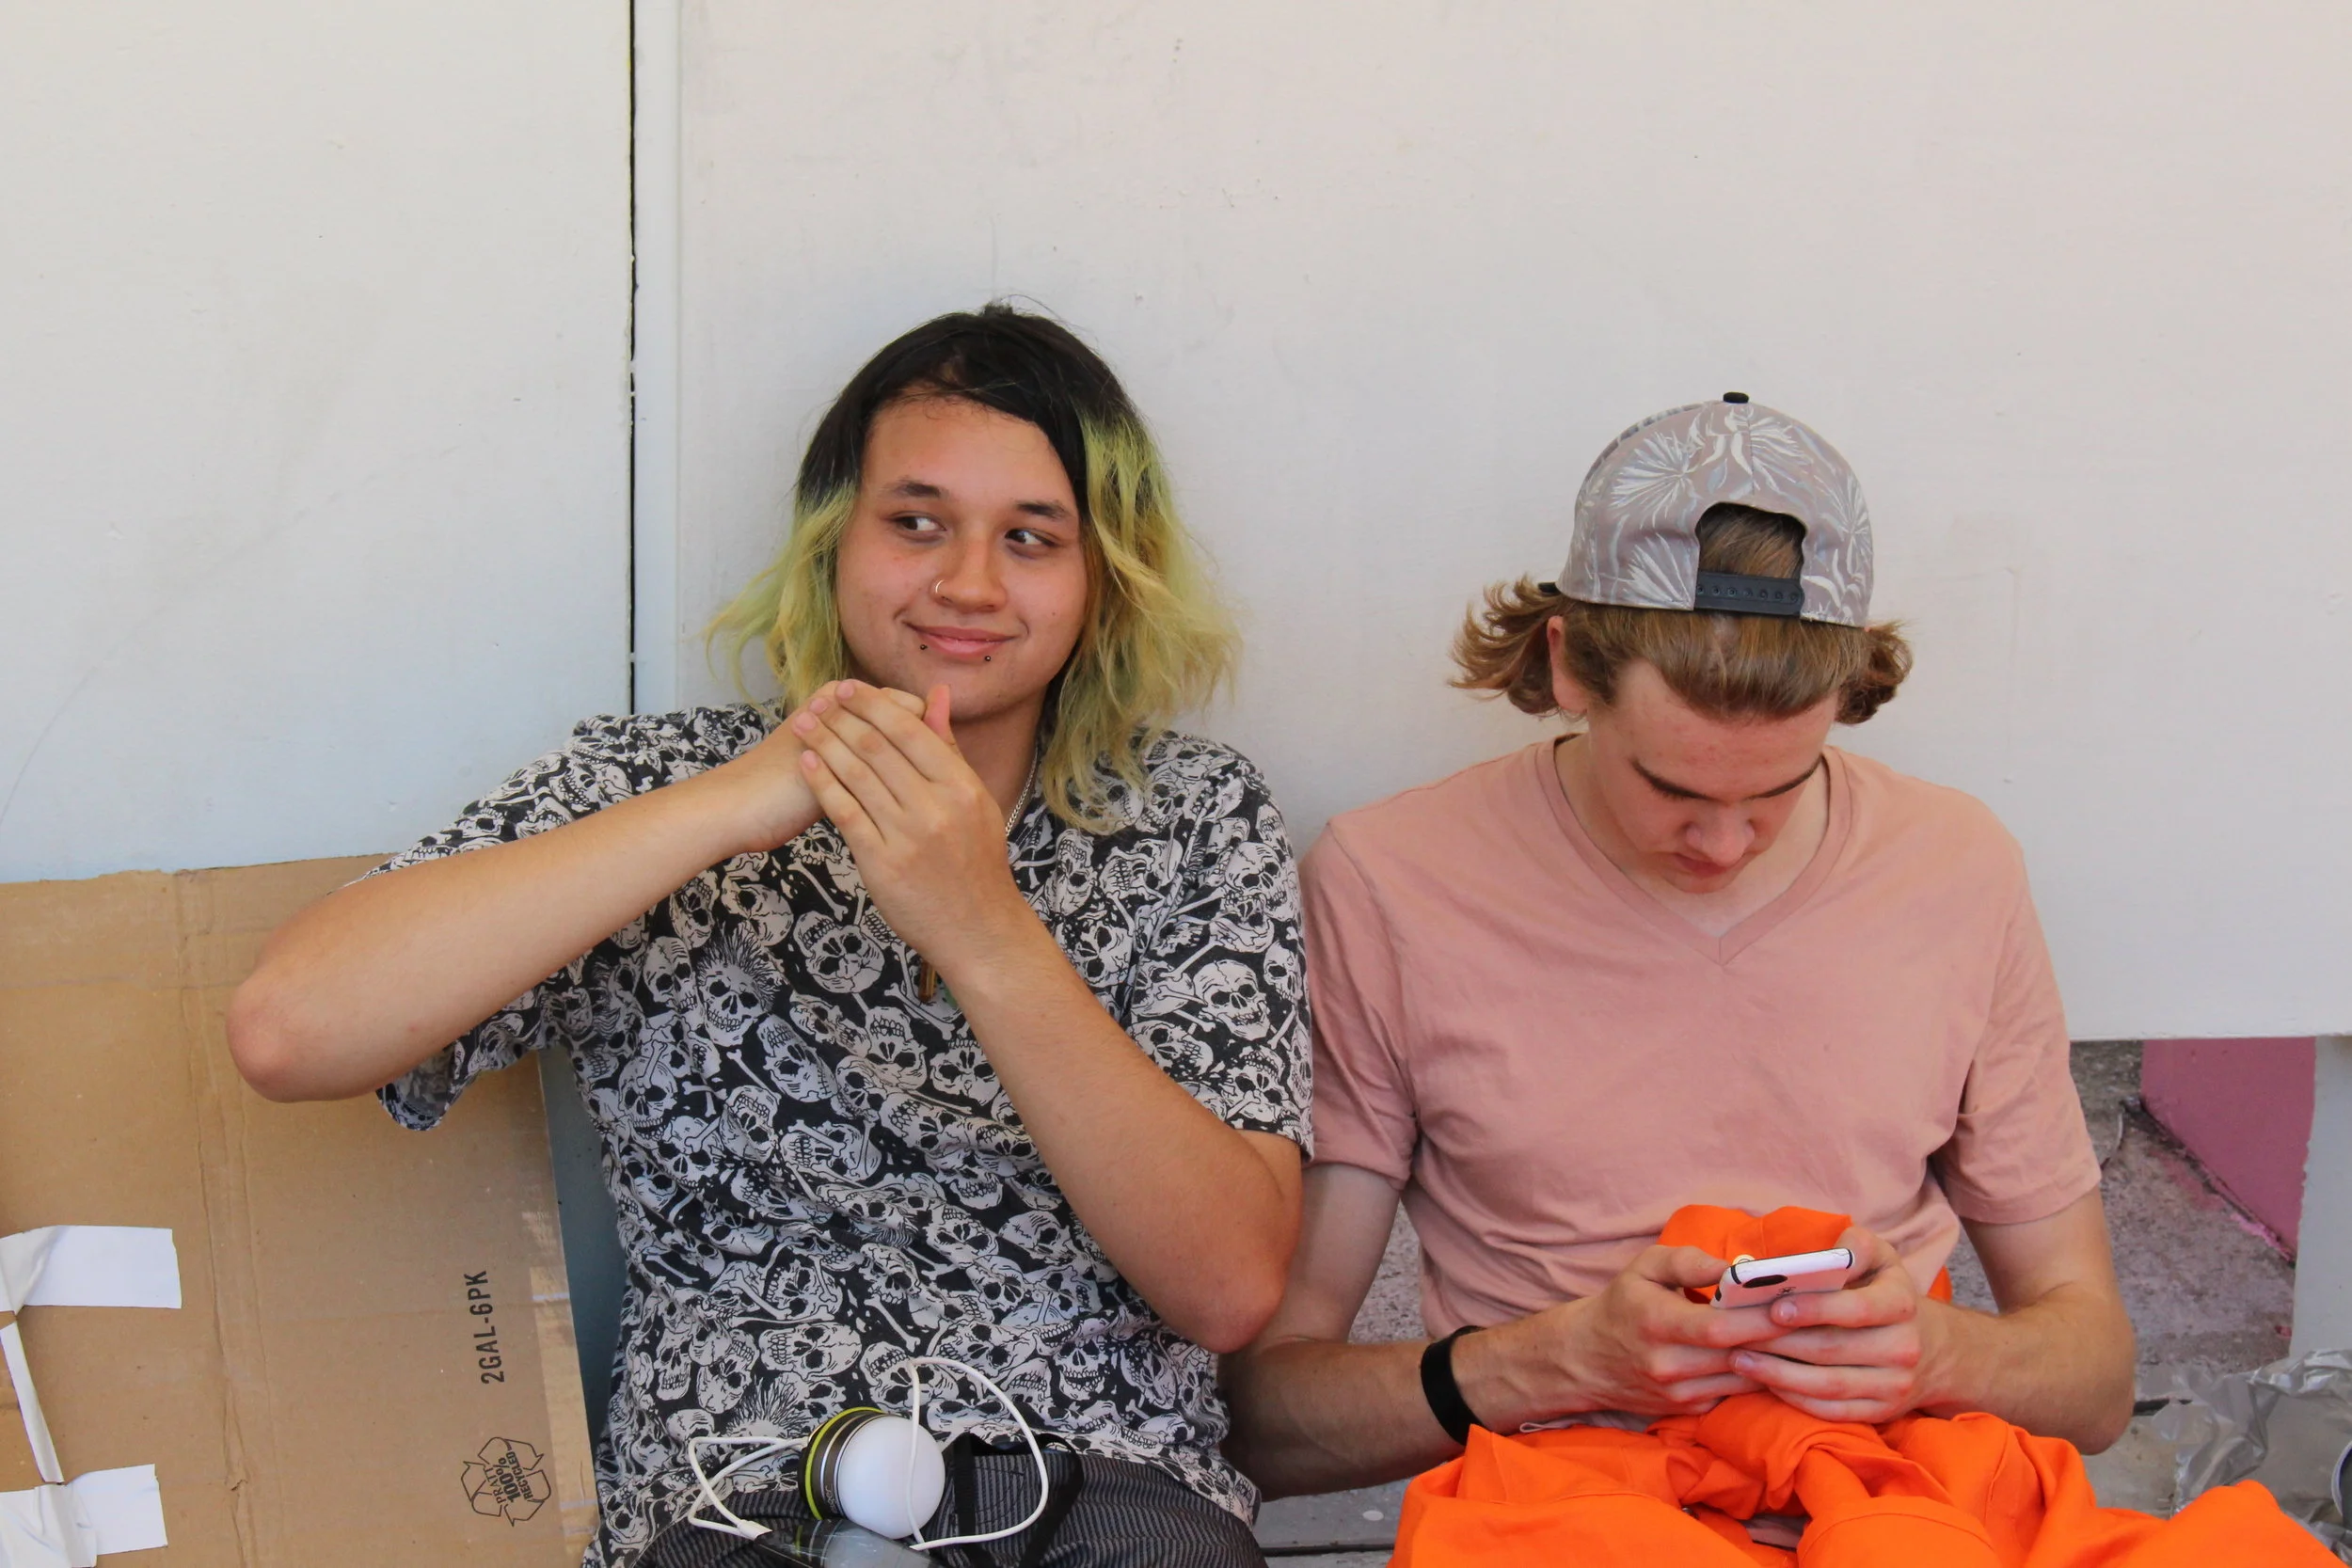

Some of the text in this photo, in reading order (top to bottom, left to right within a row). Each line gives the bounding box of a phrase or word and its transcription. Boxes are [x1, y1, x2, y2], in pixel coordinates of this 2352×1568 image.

[464, 1270, 504, 1385] 2GAL-6PK
[484, 1467, 507, 1504] PRATT
[493, 1457, 521, 1503] 100%
[506, 1451, 533, 1500] RECYCLED
